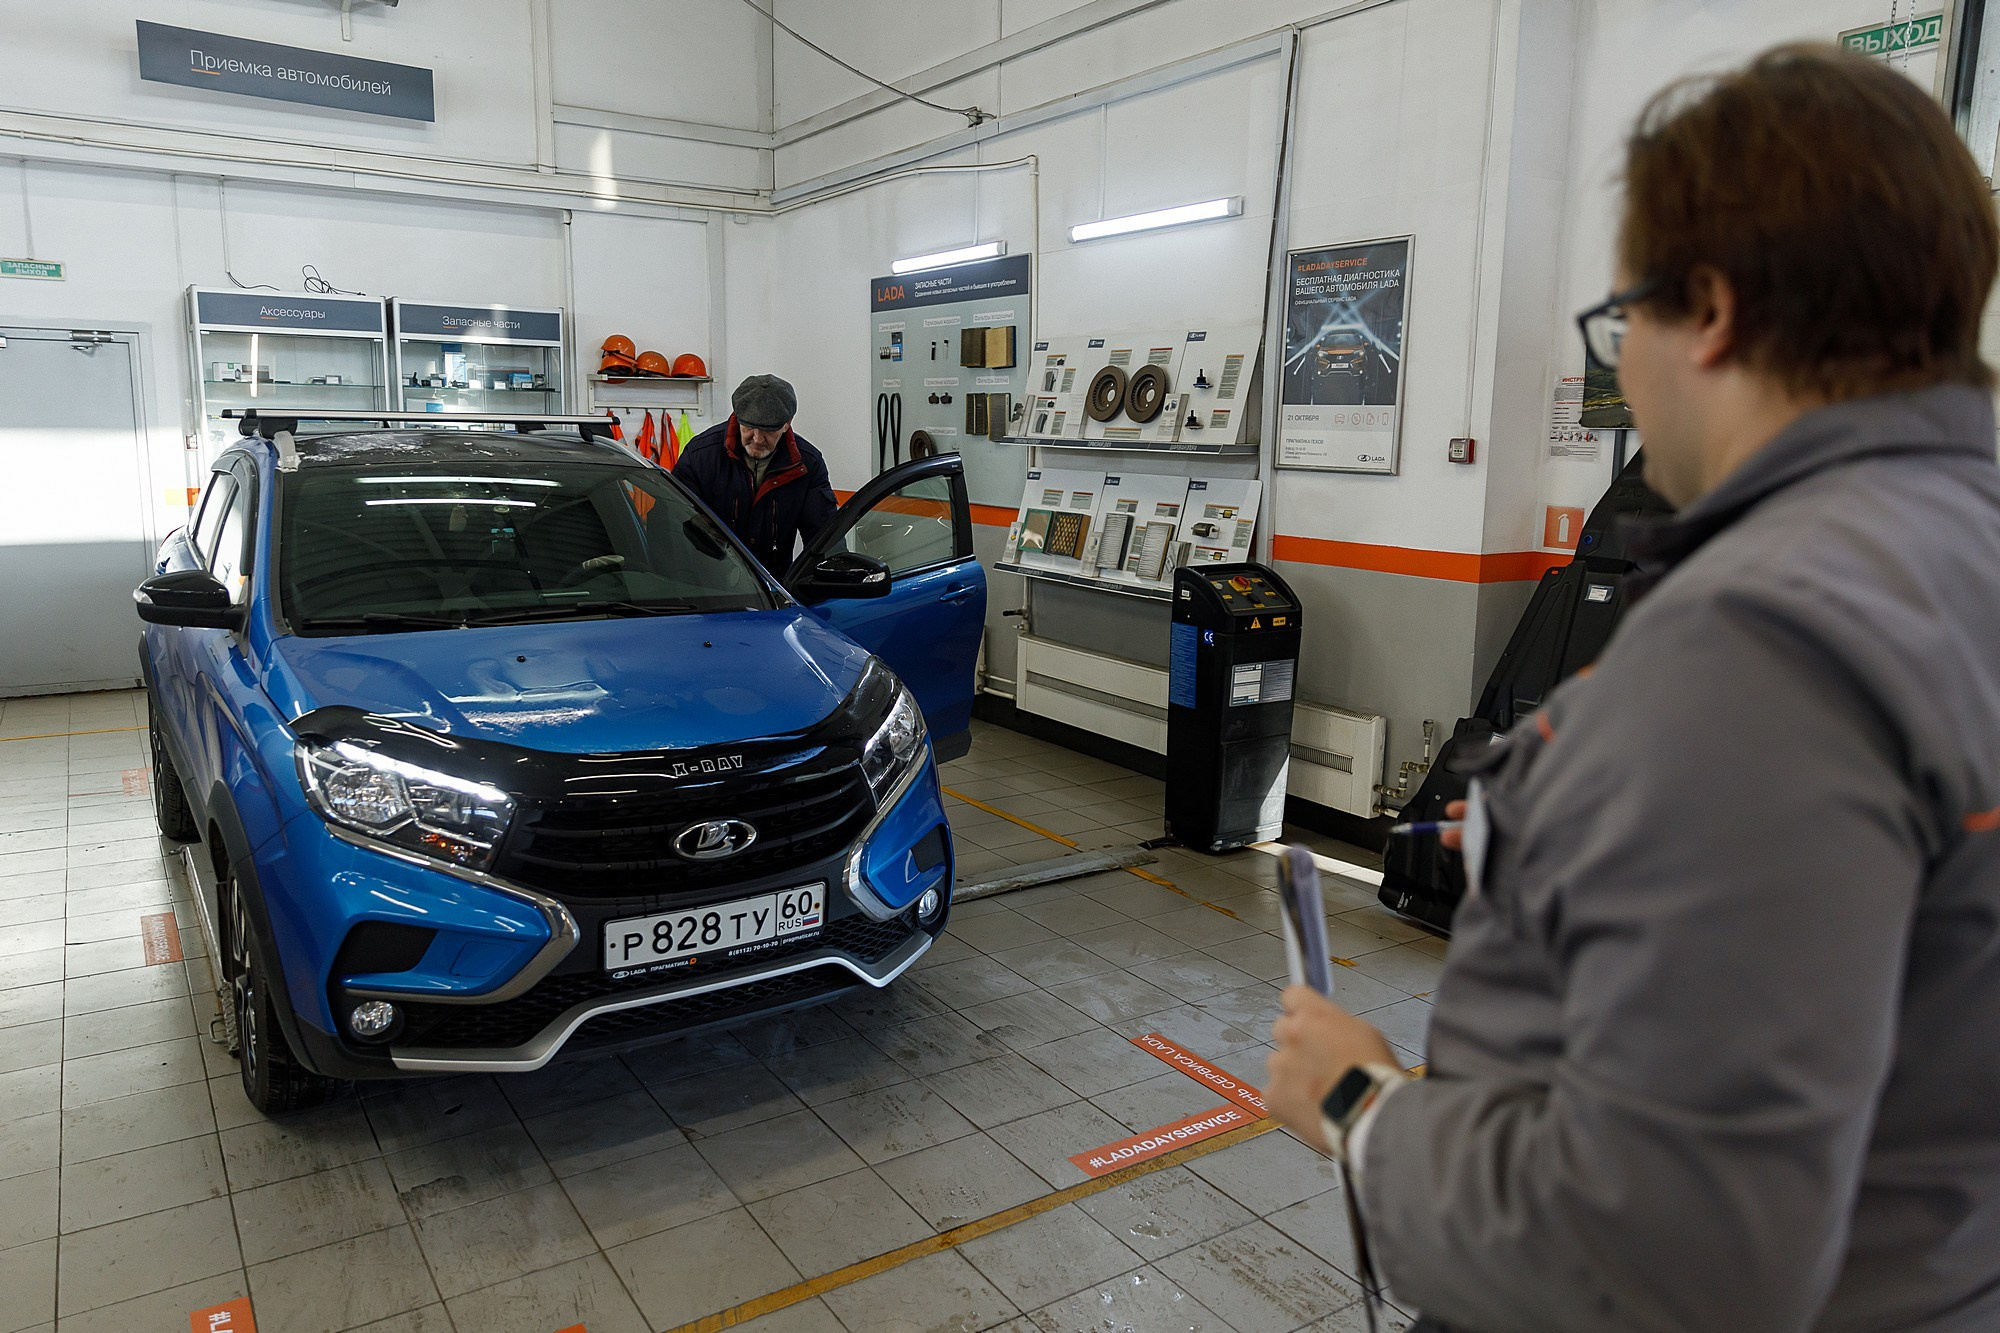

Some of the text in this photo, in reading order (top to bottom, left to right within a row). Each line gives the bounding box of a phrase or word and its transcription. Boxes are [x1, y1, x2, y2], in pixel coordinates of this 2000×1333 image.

[1849, 20, 1941, 52] ВЫХОД
[190, 50, 391, 95] Приемка автомобилей
[7, 262, 56, 270] ЗАПАСНЫЙ
[1297, 258, 1368, 272] #LADADAYSERVICE
[1296, 269, 1400, 286] БЕСПЛАТНАЯ ДИАГНОСТИКА
[877, 285, 905, 302] LADA
[1295, 280, 1399, 295] ВАШЕГО АВТОМОБИЛЯ LADA
[260, 306, 326, 320] Аксессуары
[443, 316, 520, 329] Запасные части
[672, 755, 743, 776] X-RAY
[782, 891, 813, 919] 60
[778, 918, 802, 931] RUS
[782, 931, 819, 944] pragmaticar.ru
[650, 961, 689, 972] ПРАГМАТИКА
[1141, 1035, 1175, 1055] LADA
[1174, 1053, 1235, 1089] СЕРВИСА
[1089, 1110, 1241, 1169] #LADADAYSERVICE
